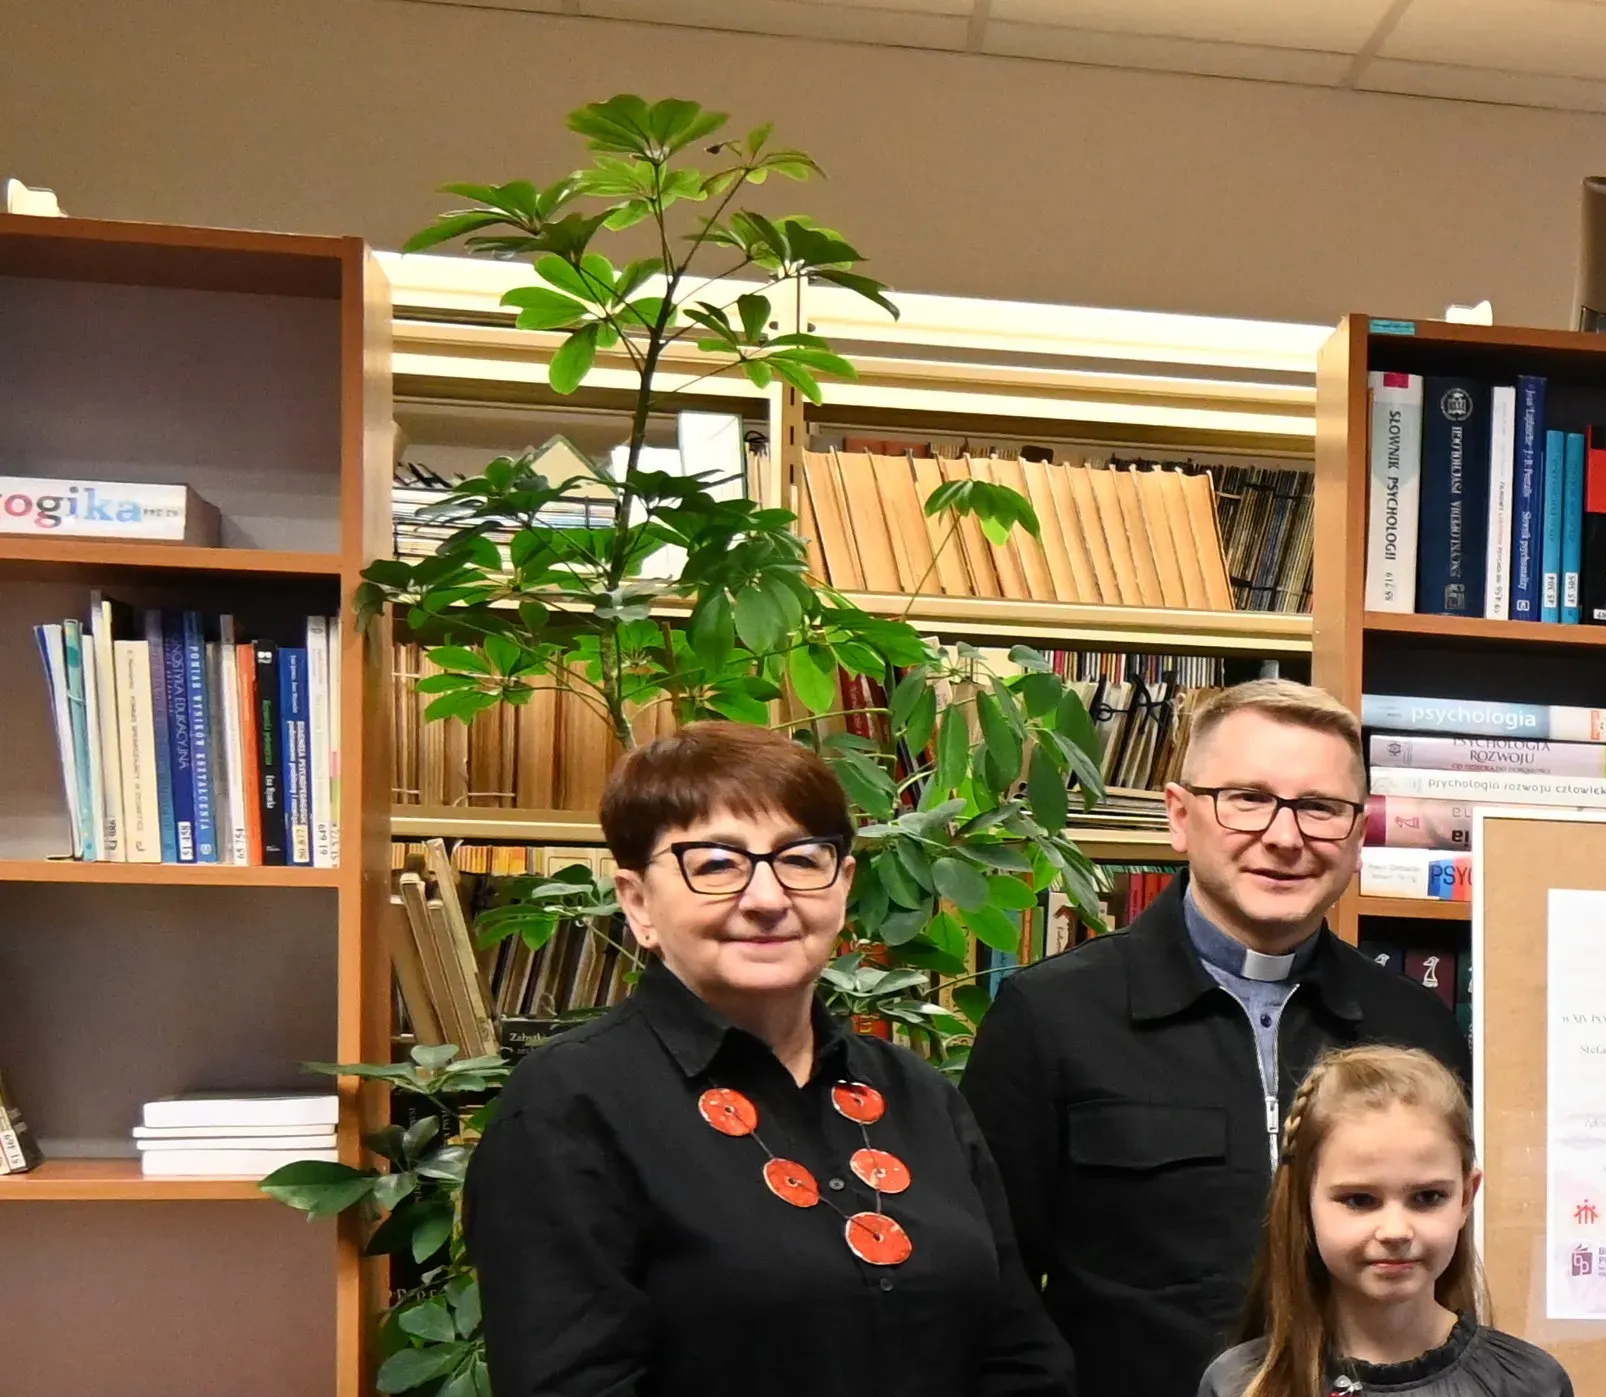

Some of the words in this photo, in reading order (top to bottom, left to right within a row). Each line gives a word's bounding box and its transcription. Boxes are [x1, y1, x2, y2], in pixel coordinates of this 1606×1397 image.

[1388, 410, 1401, 468] SŁOWNIK
[1451, 427, 1462, 494] PSYCHOLOGII
[0, 486, 142, 528] ogika
[1385, 477, 1399, 561] PSYCHOLOGII
[1520, 511, 1532, 537] Słownik
[1517, 540, 1531, 590] psychoanalizy
[190, 646, 202, 689] POMIAR
[174, 697, 190, 769] EDUKACYJNA
[192, 696, 206, 747] WYNIKÓW
[1411, 705, 1536, 731] psychologia
[1470, 749, 1535, 764] ROZWOJU
[1428, 778, 1499, 792] psychologia
[1504, 781, 1551, 793] rozwoju
